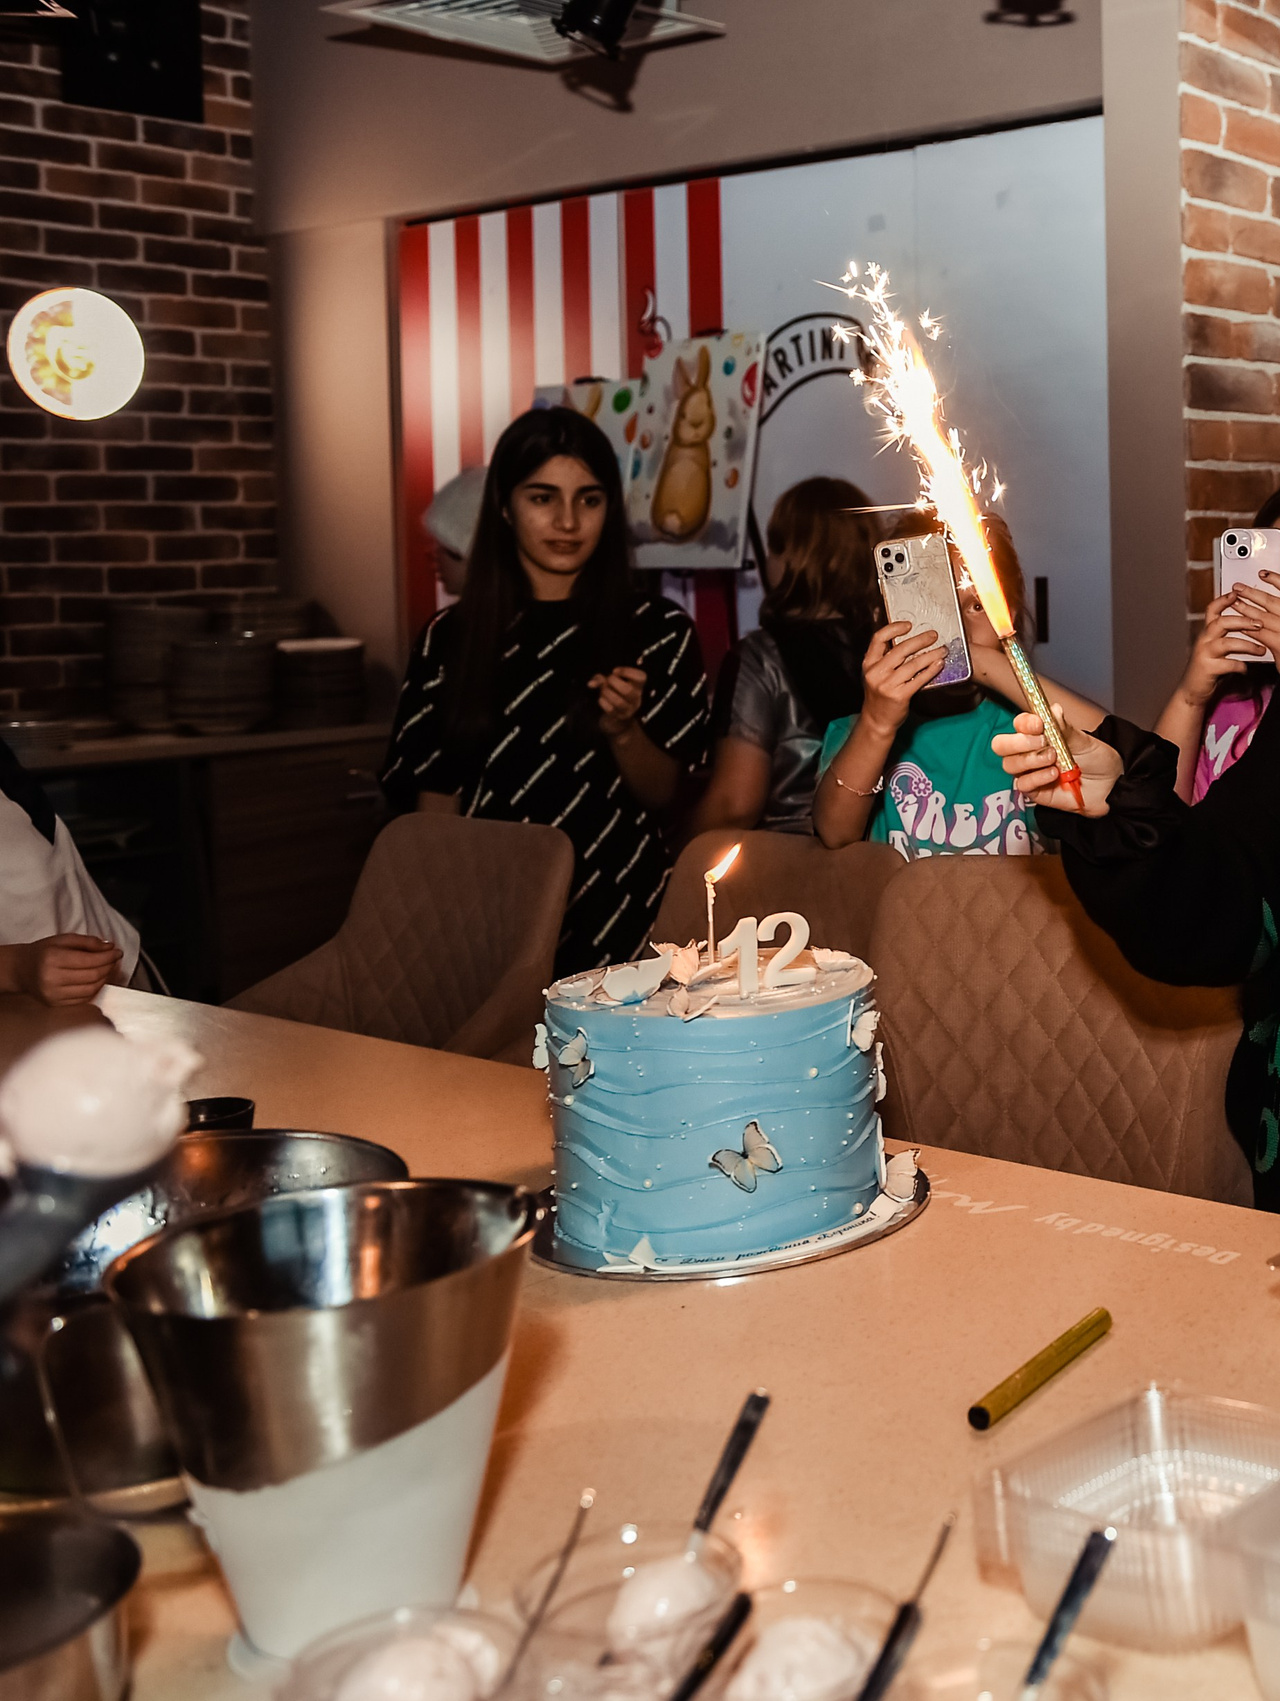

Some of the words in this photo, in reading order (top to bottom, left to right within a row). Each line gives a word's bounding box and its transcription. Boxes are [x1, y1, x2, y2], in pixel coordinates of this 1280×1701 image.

[897, 779, 1027, 848] GREA
[717, 911, 817, 1000] 12
[1033, 1210, 1082, 1234] by
[1073, 1221, 1242, 1266] Designed
